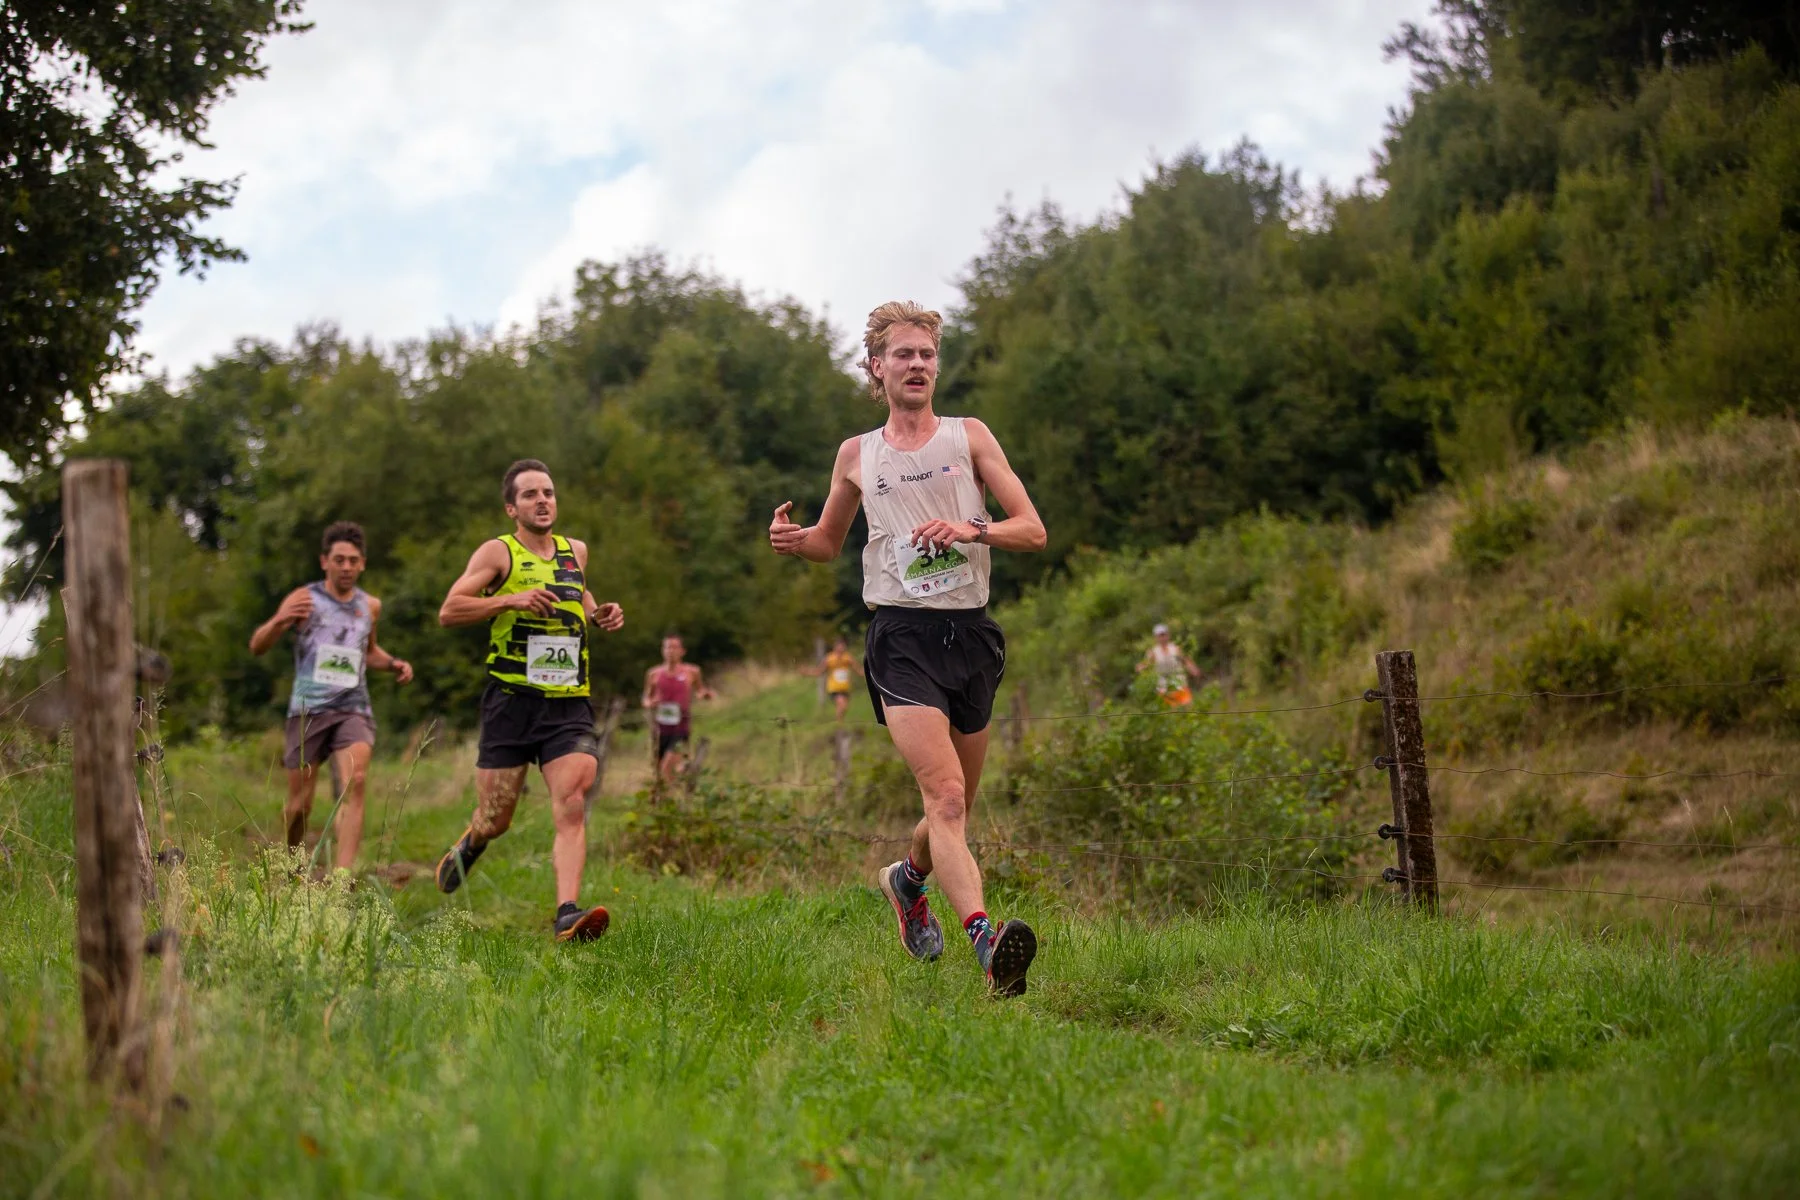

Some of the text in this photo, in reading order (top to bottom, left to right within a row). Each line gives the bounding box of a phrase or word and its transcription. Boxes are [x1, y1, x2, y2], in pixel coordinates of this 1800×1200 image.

[906, 471, 933, 482] BANDIT
[917, 541, 950, 568] 34
[545, 647, 567, 663] 20
